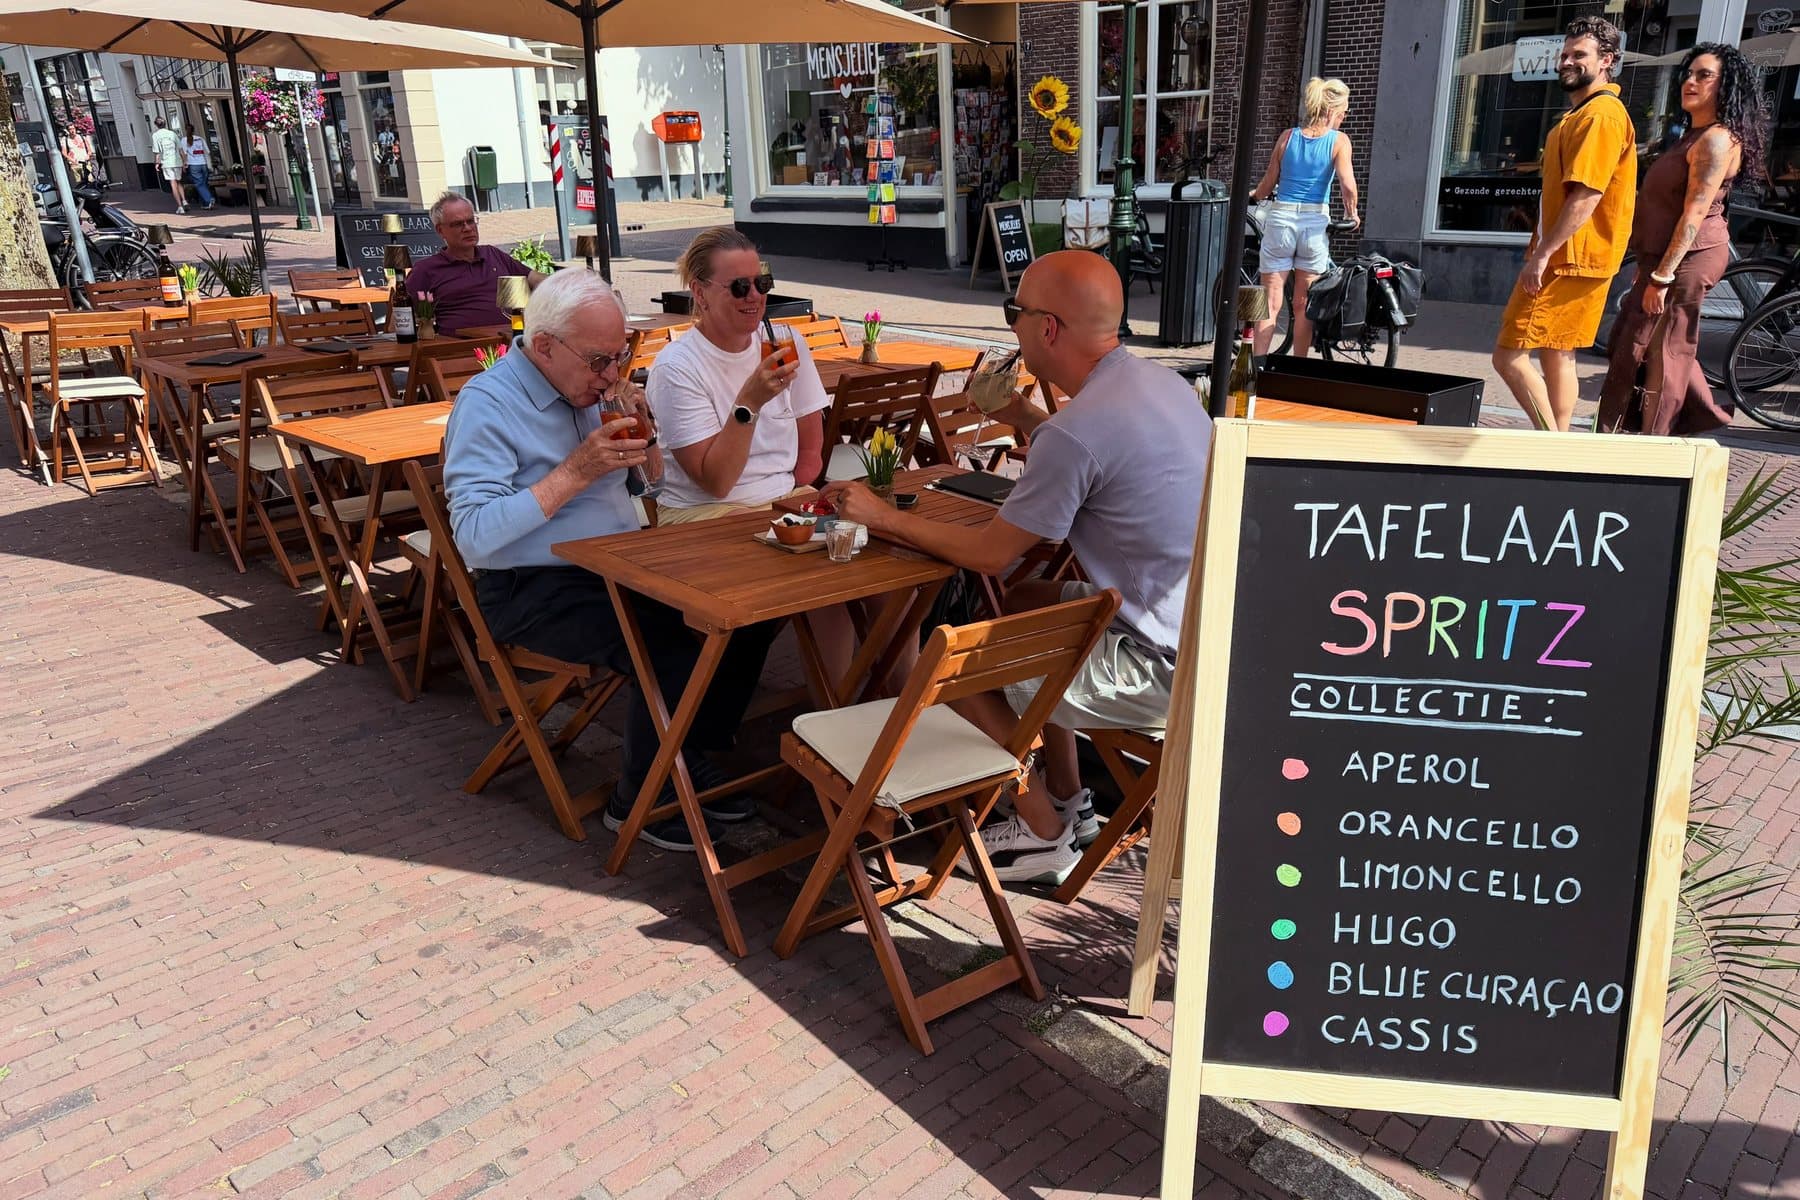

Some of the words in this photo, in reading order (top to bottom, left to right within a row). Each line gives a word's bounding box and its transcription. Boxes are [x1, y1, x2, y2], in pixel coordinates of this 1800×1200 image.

[806, 42, 886, 80] MENSJELIEF
[1518, 48, 1561, 75] wit
[1455, 187, 1490, 195] Gezonde
[355, 220, 372, 231] DE
[372, 217, 432, 231] TLAAR
[1004, 248, 1028, 263] OPEN
[1294, 503, 1629, 572] TAFELAAR
[1321, 590, 1592, 667] SPRITZ
[1342, 751, 1489, 788] APEROL
[1340, 811, 1578, 849] ORANCELLO
[1340, 856, 1581, 904] LIMONCELLO
[1335, 912, 1456, 948] HUGO
[1328, 962, 1429, 998] BLUE
[1441, 972, 1623, 1017] CURAÇAO
[1322, 1015, 1477, 1053] CASSIS
